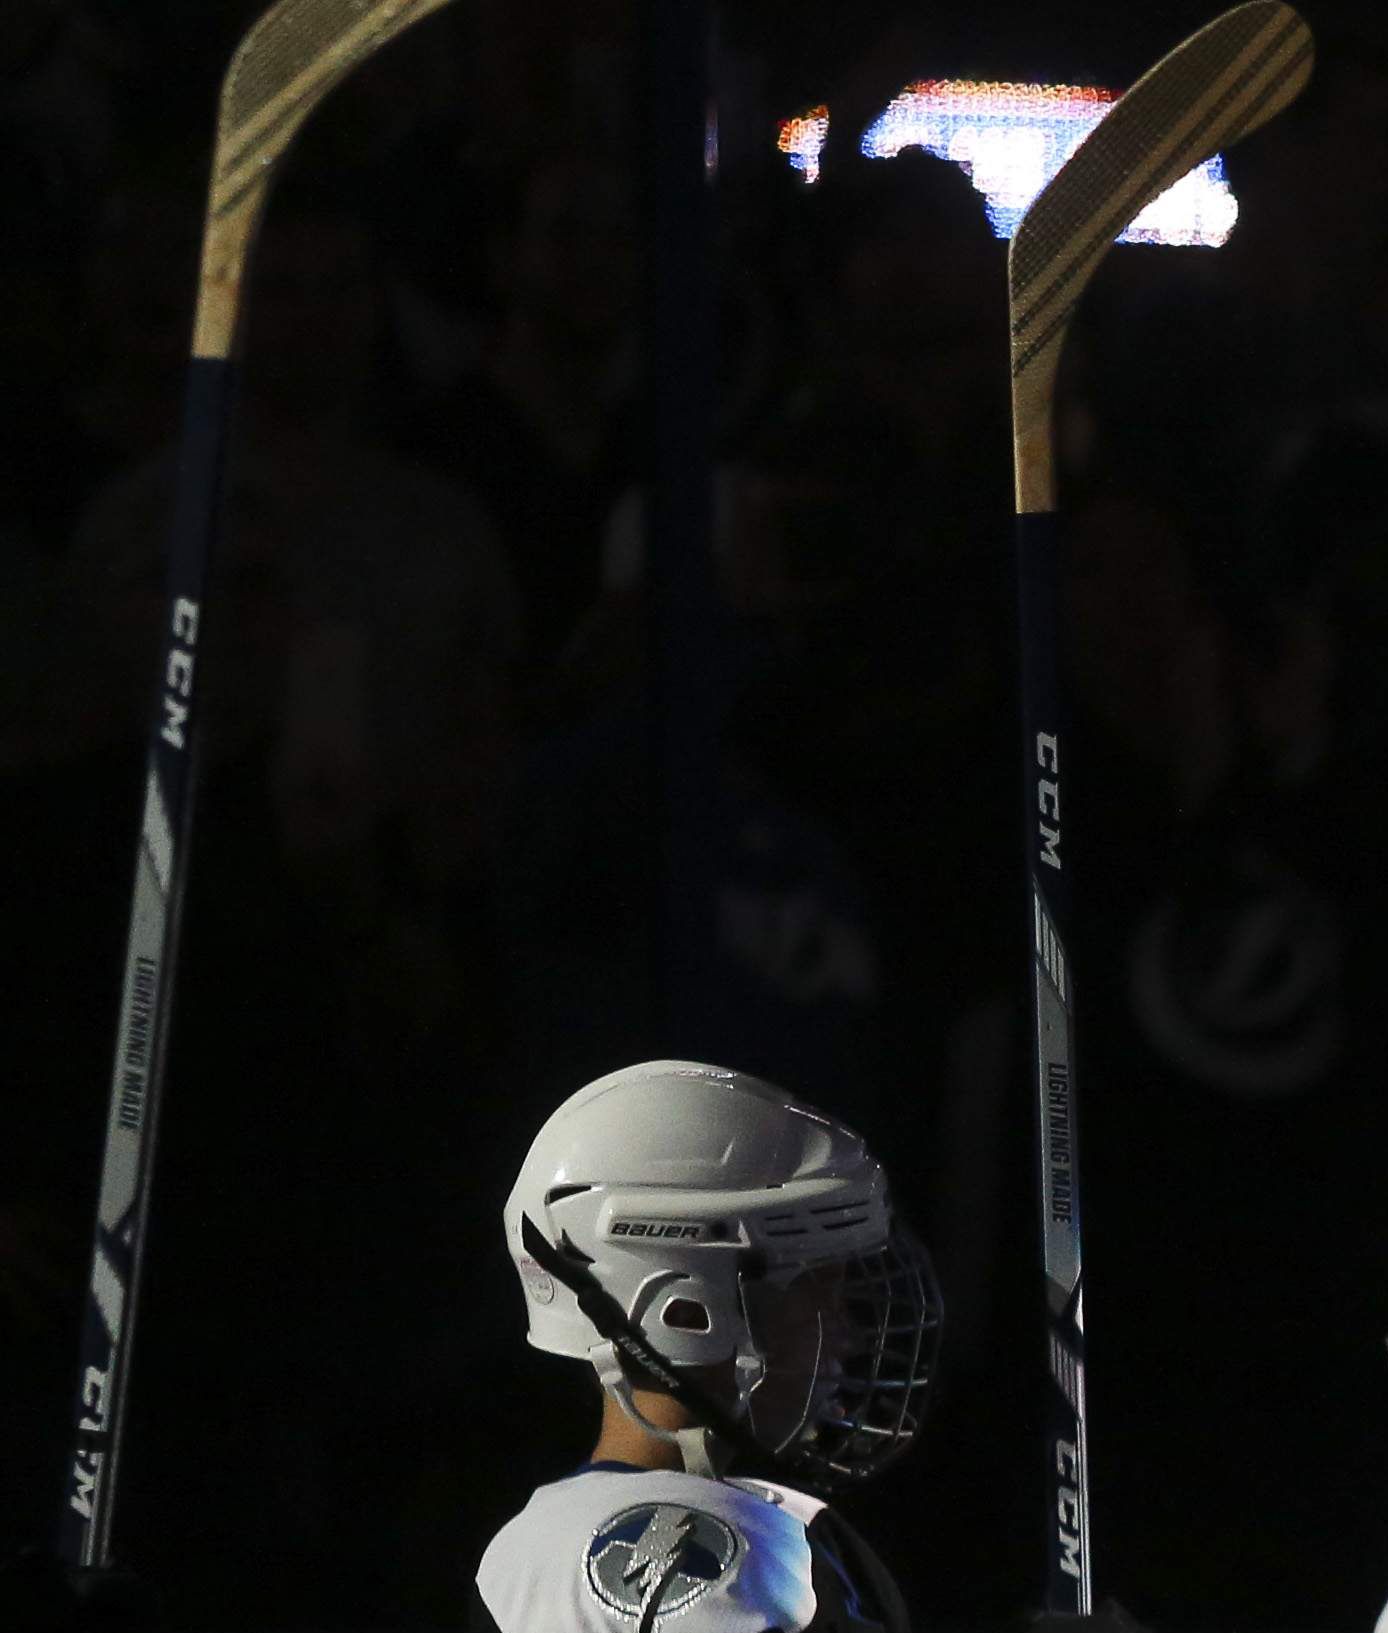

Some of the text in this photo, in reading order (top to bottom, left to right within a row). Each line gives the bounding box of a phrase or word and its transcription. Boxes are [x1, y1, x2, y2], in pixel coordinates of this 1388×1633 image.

[160, 597, 199, 750] CCM
[1036, 731, 1061, 870] CCM
[1047, 1062, 1073, 1226] LIGHTNING MADE
[610, 1221, 700, 1240] BAUER
[1056, 1438, 1080, 1579] CCM
